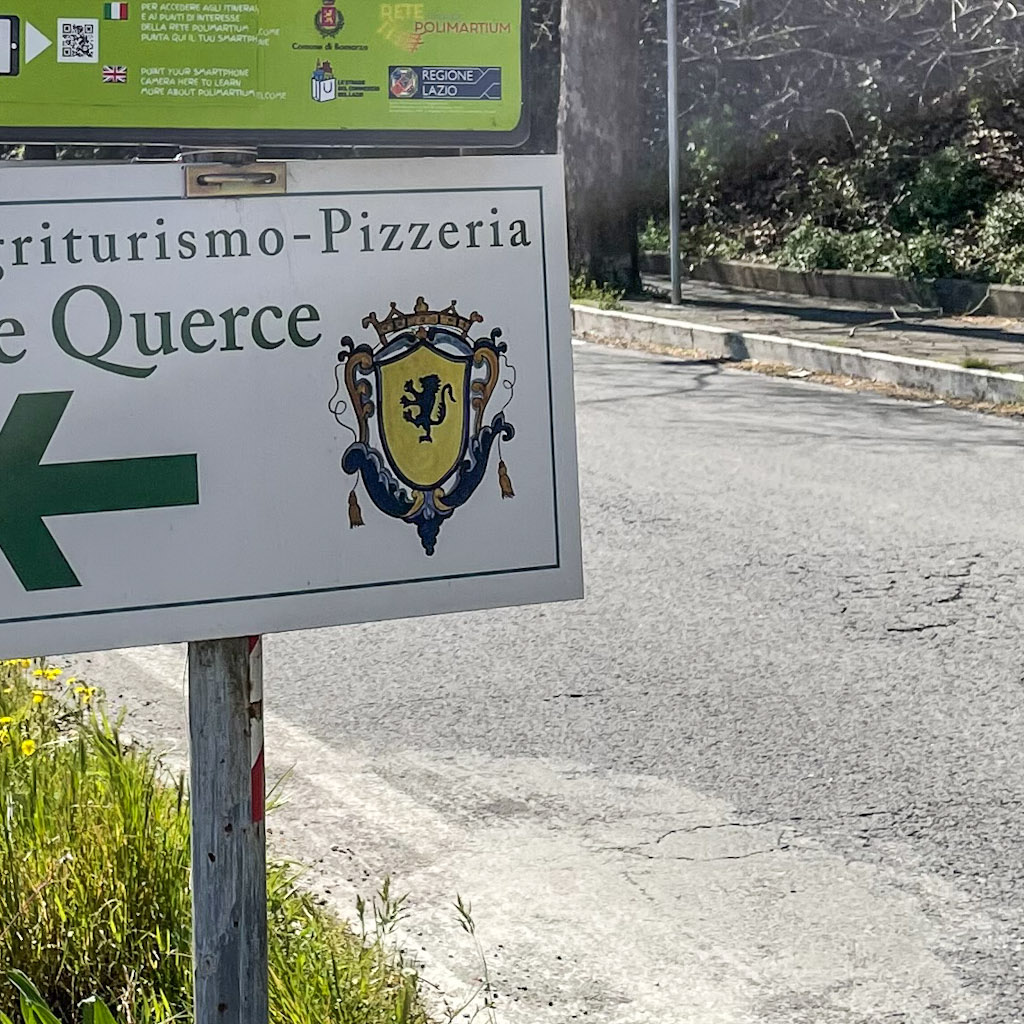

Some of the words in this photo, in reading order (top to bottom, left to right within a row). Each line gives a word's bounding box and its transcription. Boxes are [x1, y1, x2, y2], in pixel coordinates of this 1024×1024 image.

[140, 2, 158, 11] PER
[379, 3, 424, 20] RETE
[196, 14, 240, 23] INTERESSE
[141, 23, 167, 32] DELLA
[169, 24, 189, 32] RETE
[414, 21, 511, 34] POLIMARTIUM
[141, 33, 170, 42] PUNTA
[171, 34, 187, 44] QUI
[188, 34, 196, 43] IL
[140, 67, 165, 76] POINT
[168, 68, 191, 76] YOUR
[193, 68, 249, 77] SMARTPHONE
[422, 70, 473, 81] REGIONE
[140, 77, 175, 86] CAMERA
[177, 78, 198, 86] HERE
[201, 78, 212, 86] TO
[214, 78, 241, 86] LEARN
[140, 87, 164, 96] MORE
[166, 88, 195, 97] ABOUT
[422, 85, 457, 96] LAZIO
[51, 284, 322, 378] Querce
